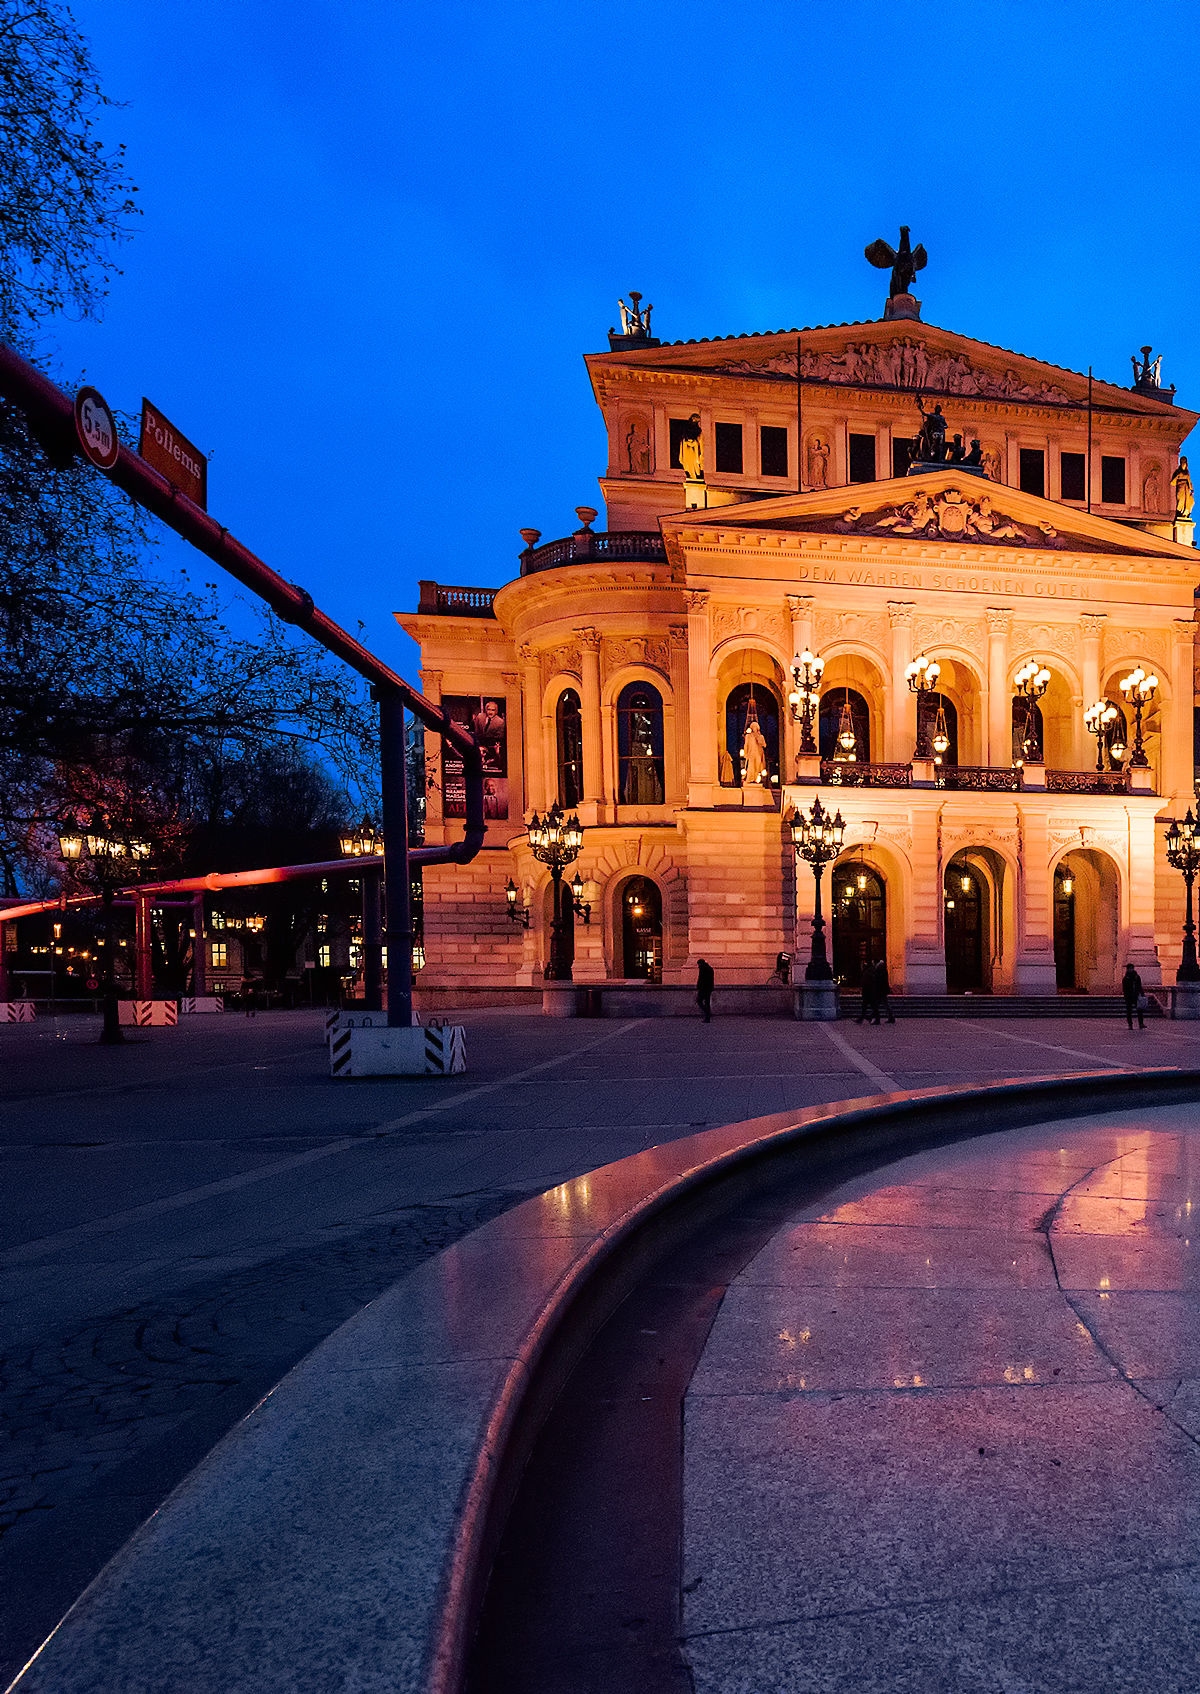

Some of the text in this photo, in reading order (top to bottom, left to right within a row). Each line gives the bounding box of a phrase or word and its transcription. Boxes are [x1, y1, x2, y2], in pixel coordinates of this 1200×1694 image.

[799, 565, 1090, 598] DEM WAHREN SCHOENEN GUTEN
